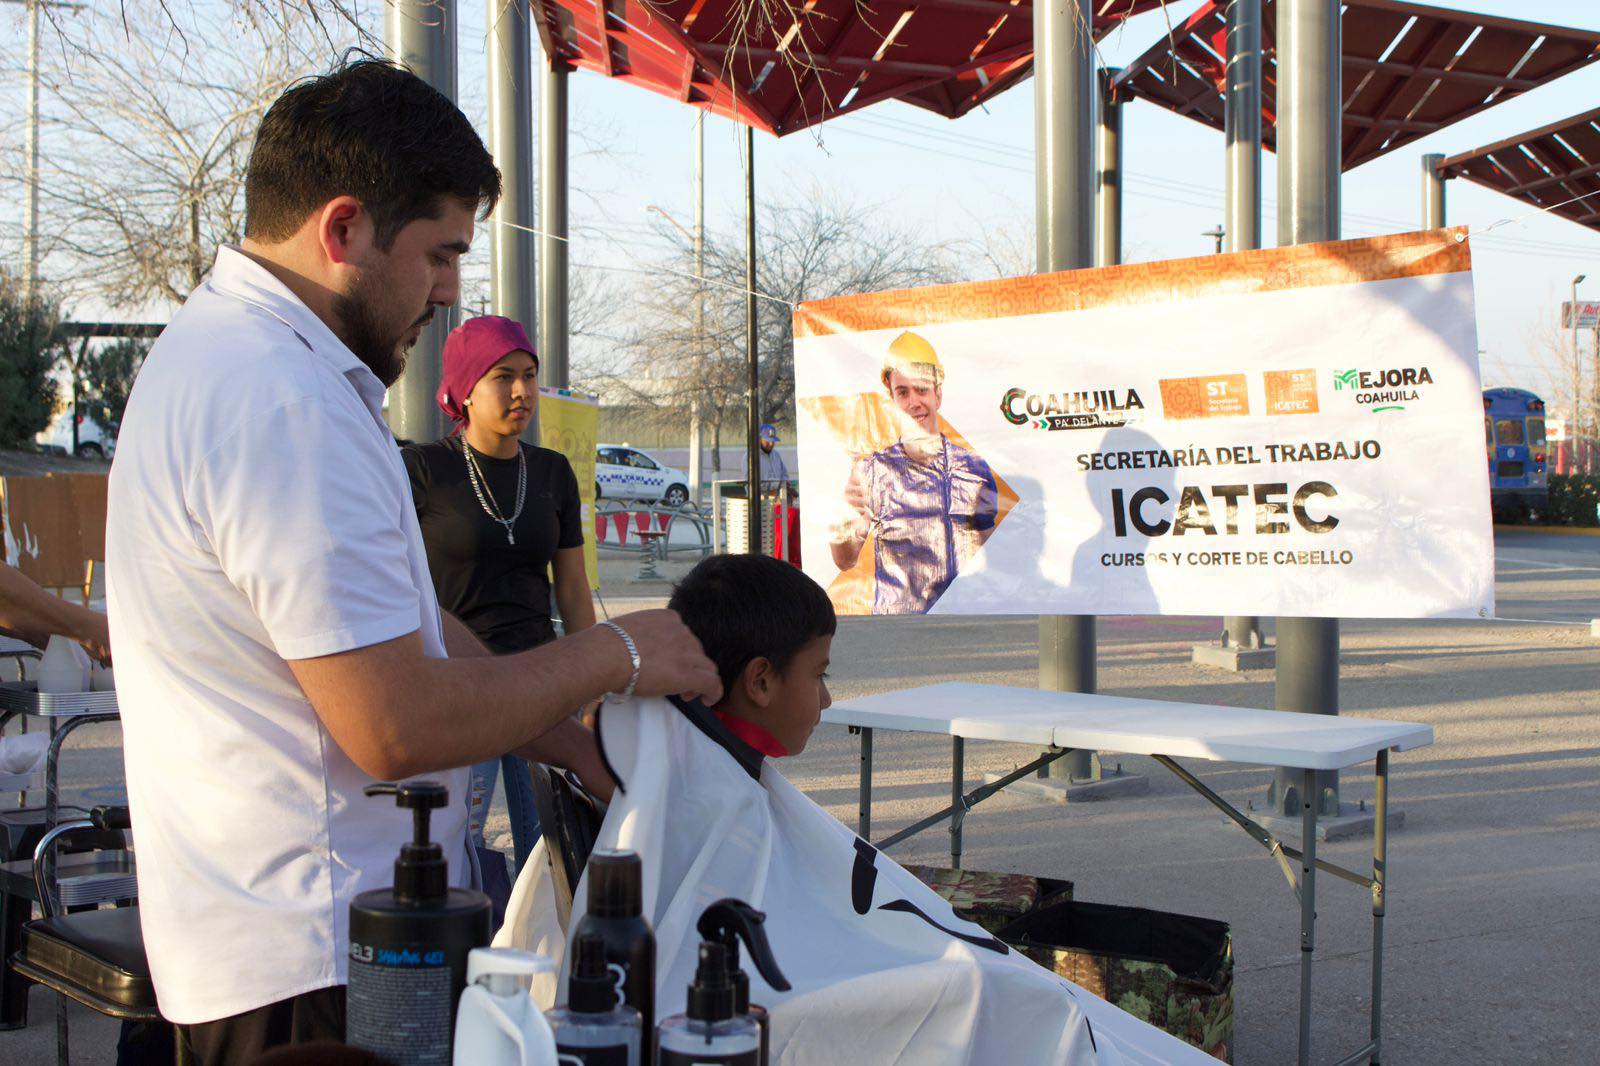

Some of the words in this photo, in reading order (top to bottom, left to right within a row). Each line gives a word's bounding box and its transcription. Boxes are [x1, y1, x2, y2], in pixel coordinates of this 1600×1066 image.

[1207, 381, 1229, 396] ST
[1334, 367, 1434, 390] MEJORA
[1000, 388, 1145, 425] COAHUILA
[1356, 390, 1420, 404] COAHUILA
[1077, 443, 1212, 471] SECRETARÍA
[1216, 446, 1261, 465] DEL
[1265, 440, 1381, 463] TRABAJO
[1111, 481, 1340, 537] ICATEC
[1101, 552, 1168, 567] CURSOS
[1172, 553, 1182, 566] Y
[1187, 552, 1242, 566] CORTE
[1246, 552, 1269, 565] DE
[1273, 550, 1353, 565] CABELLO
